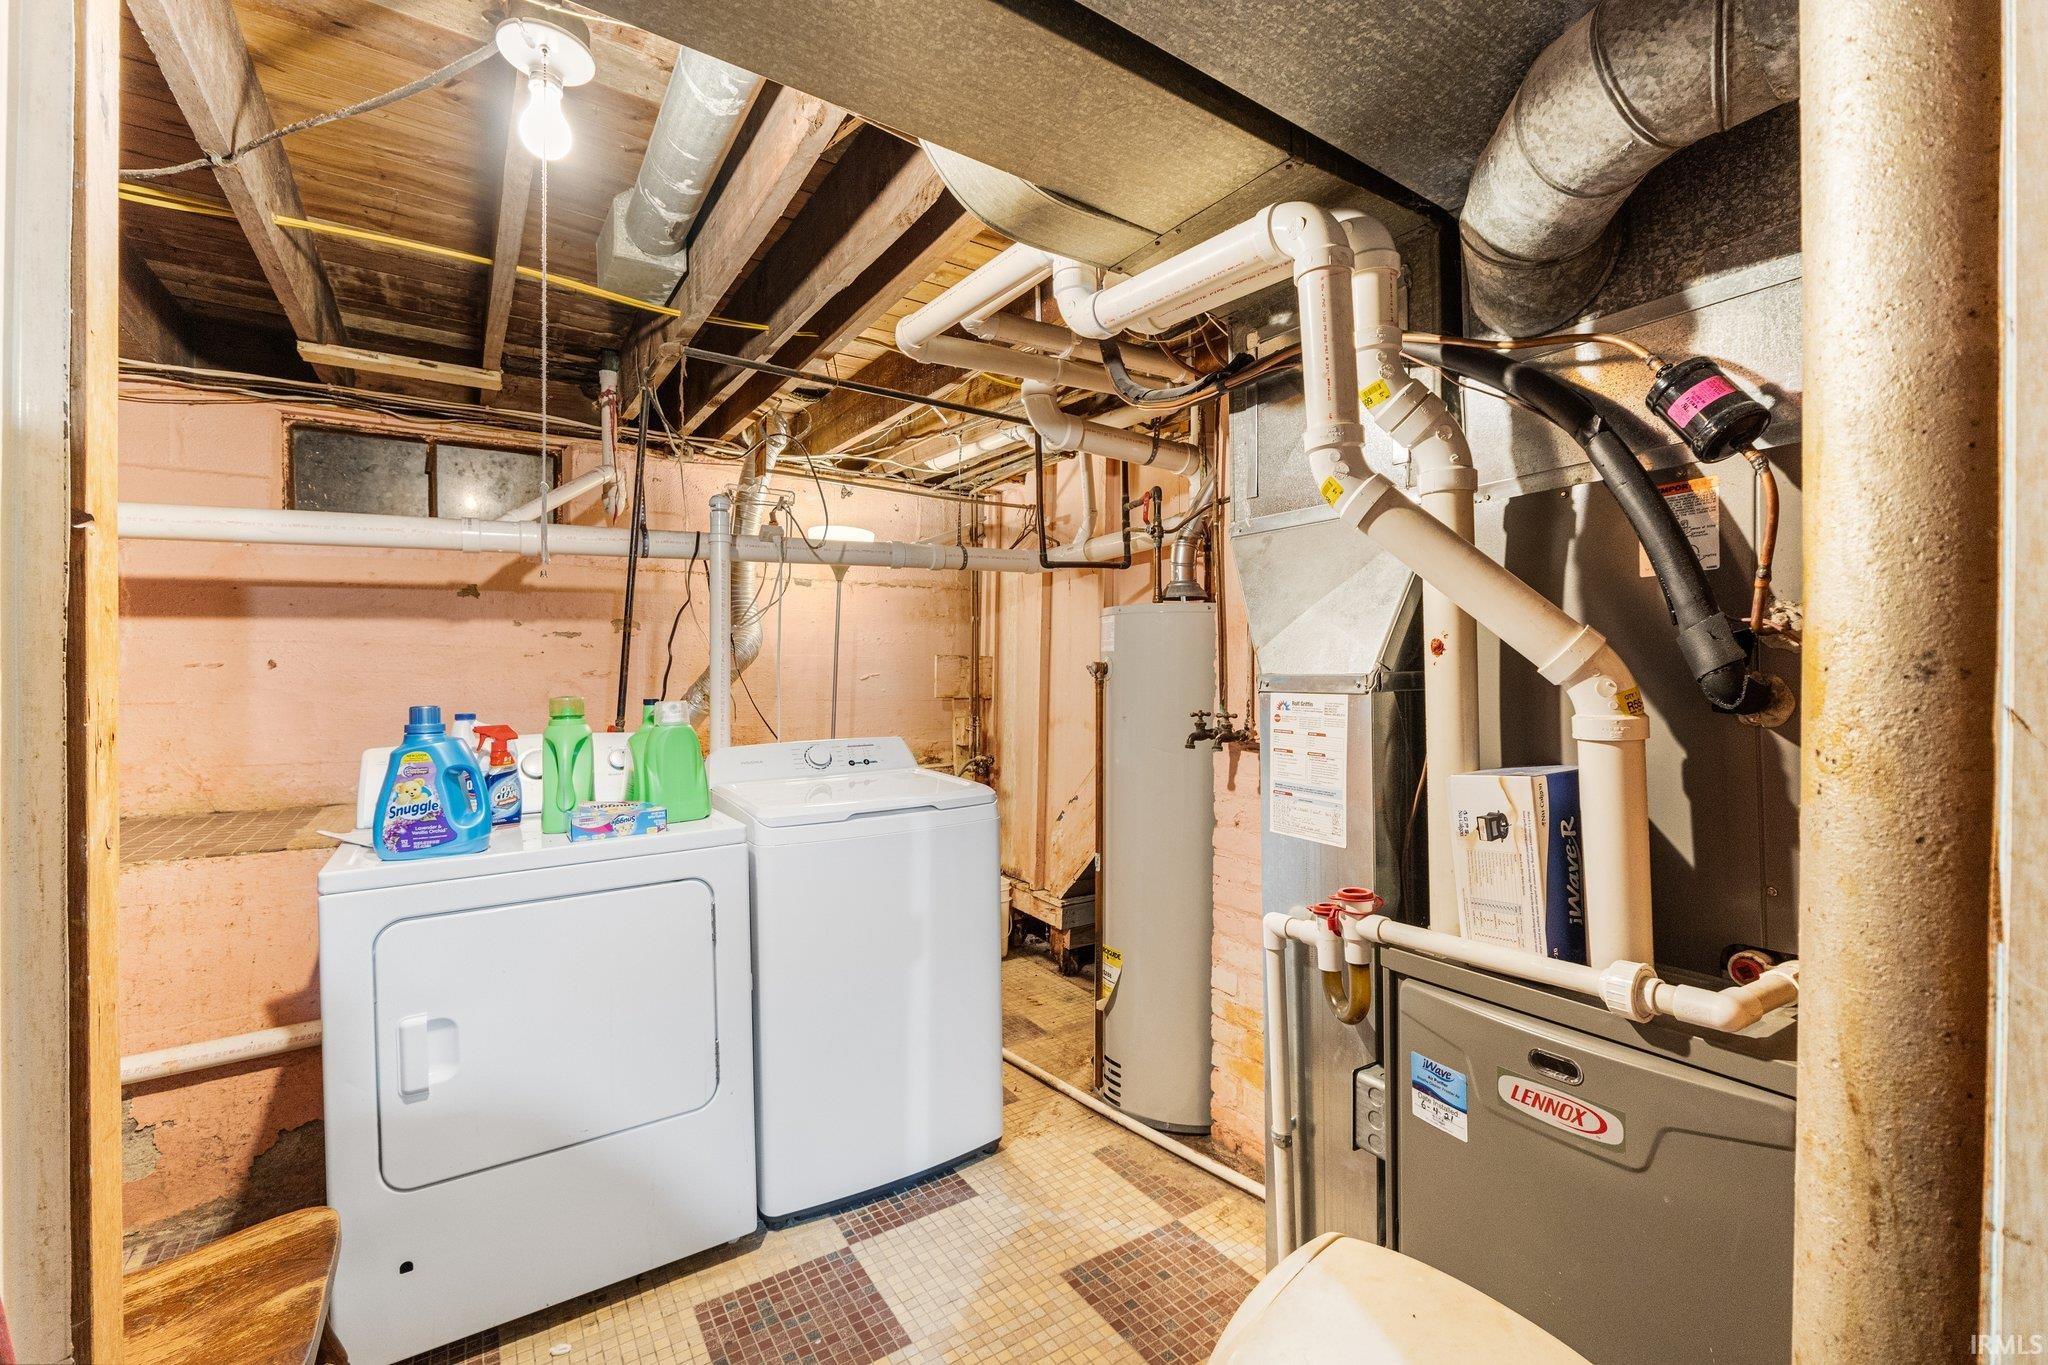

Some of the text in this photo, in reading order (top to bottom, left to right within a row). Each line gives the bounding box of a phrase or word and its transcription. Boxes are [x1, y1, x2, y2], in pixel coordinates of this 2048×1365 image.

[388, 800, 439, 819] Snuggle
[1560, 816, 1584, 925] iWave-R
[1422, 1058, 1452, 1080] iWave
[1418, 1091, 1431, 1102] Date
[1510, 1084, 1587, 1127] LENNOX
